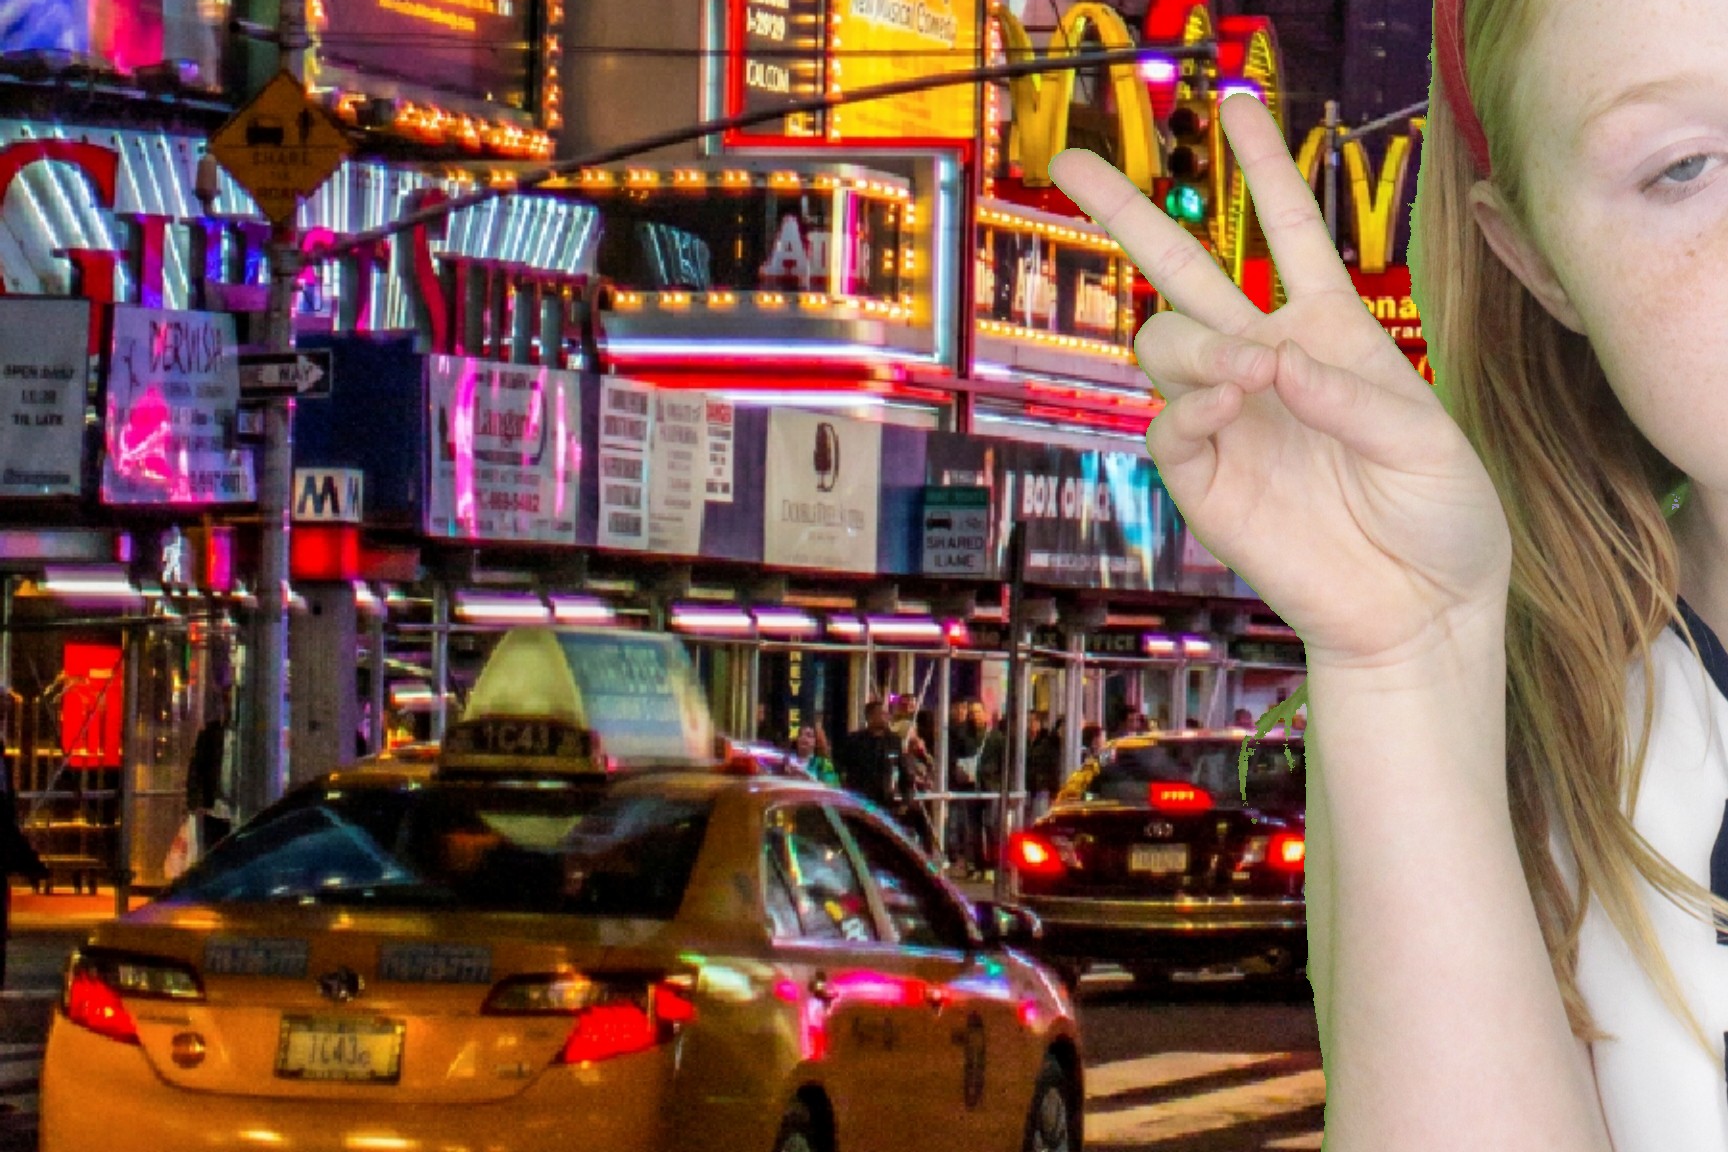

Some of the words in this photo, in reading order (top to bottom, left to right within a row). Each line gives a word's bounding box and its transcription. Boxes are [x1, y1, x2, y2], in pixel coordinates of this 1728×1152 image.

[1022, 474, 1060, 518] BOX
[926, 536, 983, 549] SHARED
[934, 554, 976, 568] LANE
